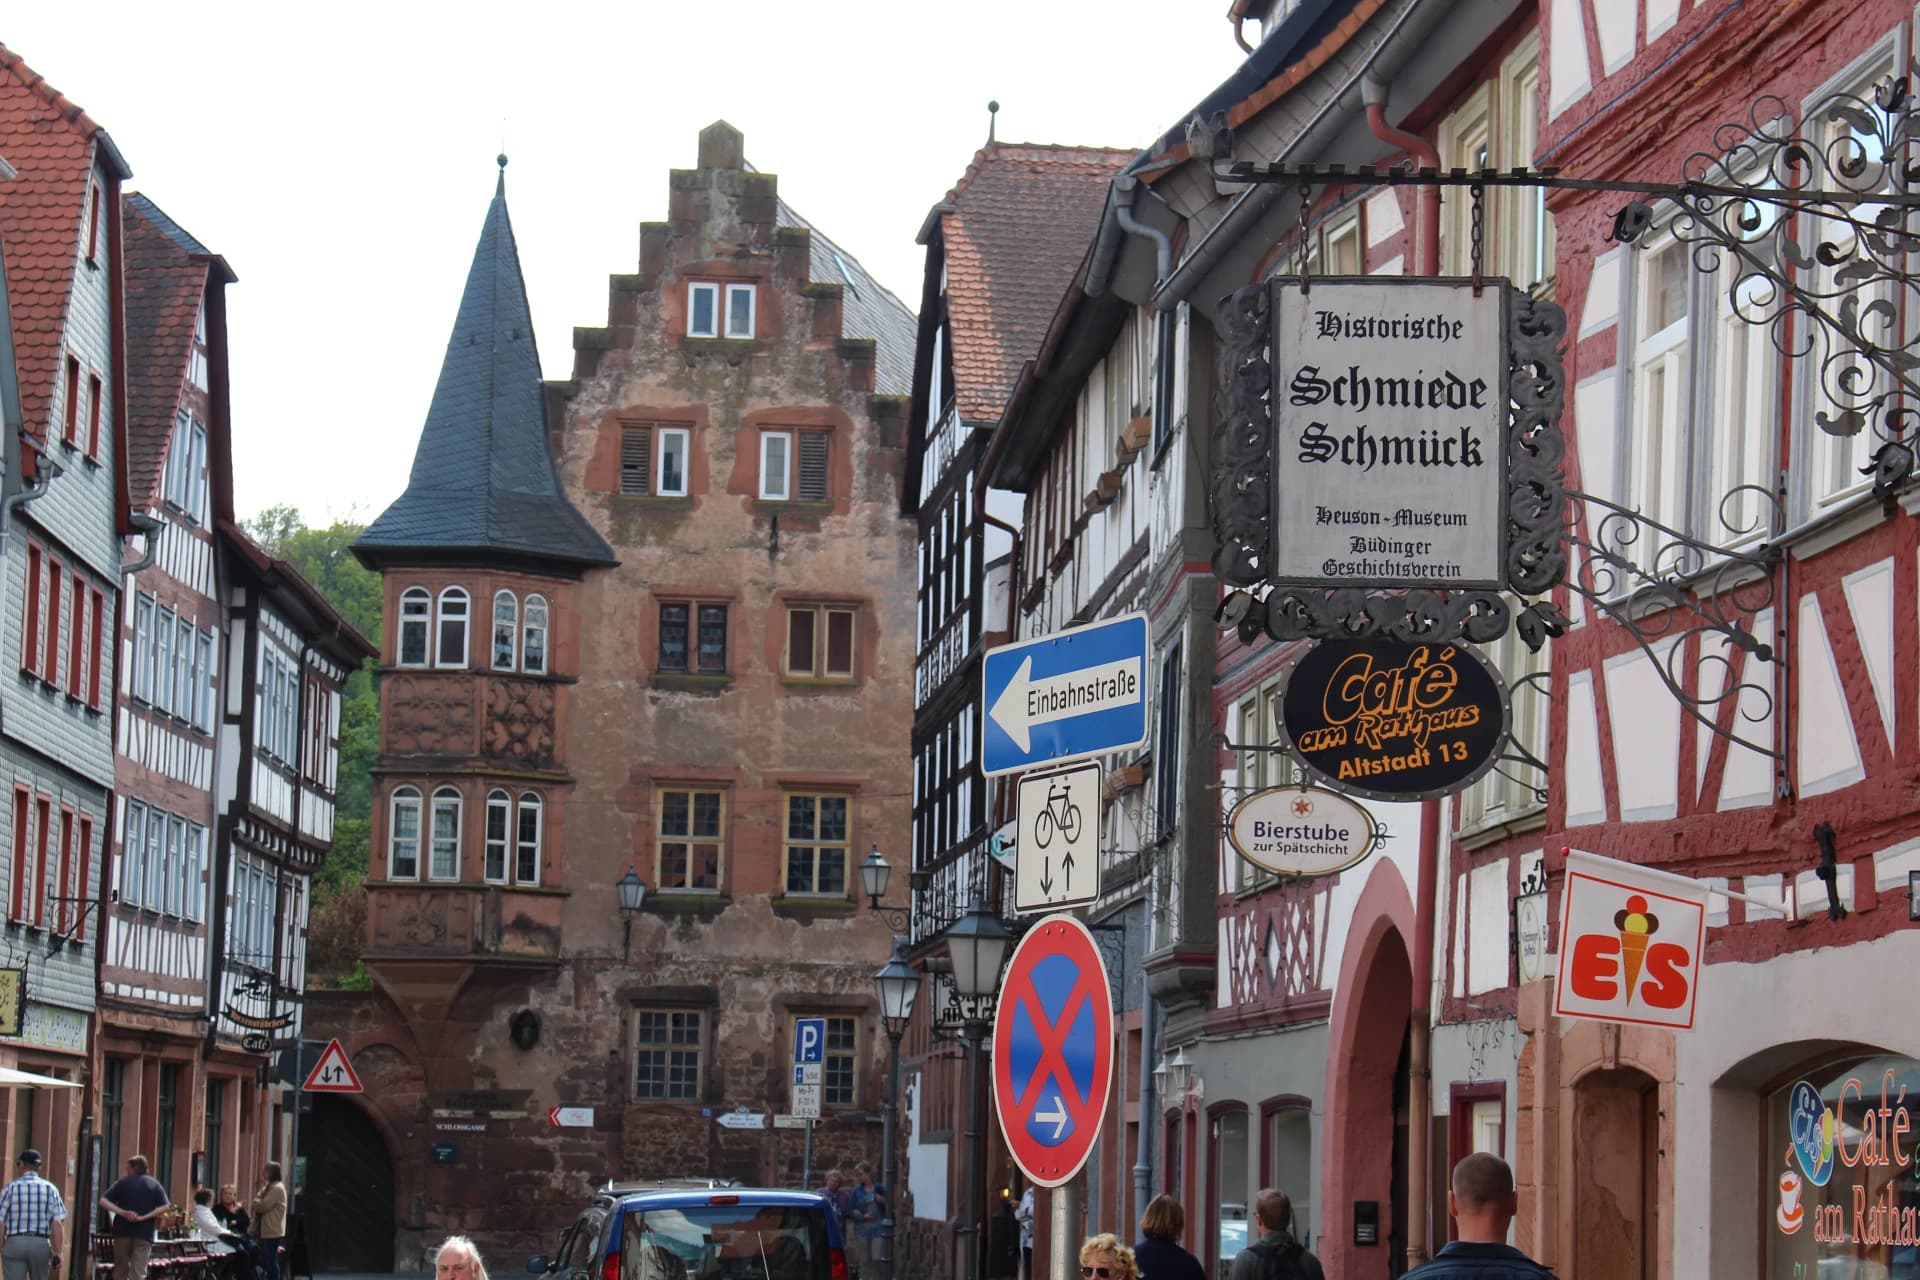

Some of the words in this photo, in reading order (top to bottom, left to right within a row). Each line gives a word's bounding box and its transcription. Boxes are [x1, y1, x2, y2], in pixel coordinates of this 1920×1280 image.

[1315, 310, 1463, 342] Historische
[1290, 365, 1488, 413] Schmiede
[1298, 421, 1484, 472] Schmück
[1349, 535, 1432, 558] Büdinger
[1322, 557, 1461, 578] Geschichtsverein
[1027, 669, 1137, 718] Einbahnstraße
[1322, 645, 1458, 726] Café
[1298, 724, 1348, 753] am
[1355, 703, 1481, 751] Rathaus
[1338, 746, 1431, 781] Altstadt
[1439, 740, 1470, 764] 13
[1253, 821, 1350, 842] Bierstube
[1253, 844, 1272, 853] zur
[1276, 841, 1349, 857] Spätschicht
[242, 1037, 268, 1051] Café
[801, 1026, 817, 1061] P
[1837, 1068, 1910, 1167] Café
[1814, 1204, 1845, 1243] am
[1851, 1181, 1920, 1246] Rathau
